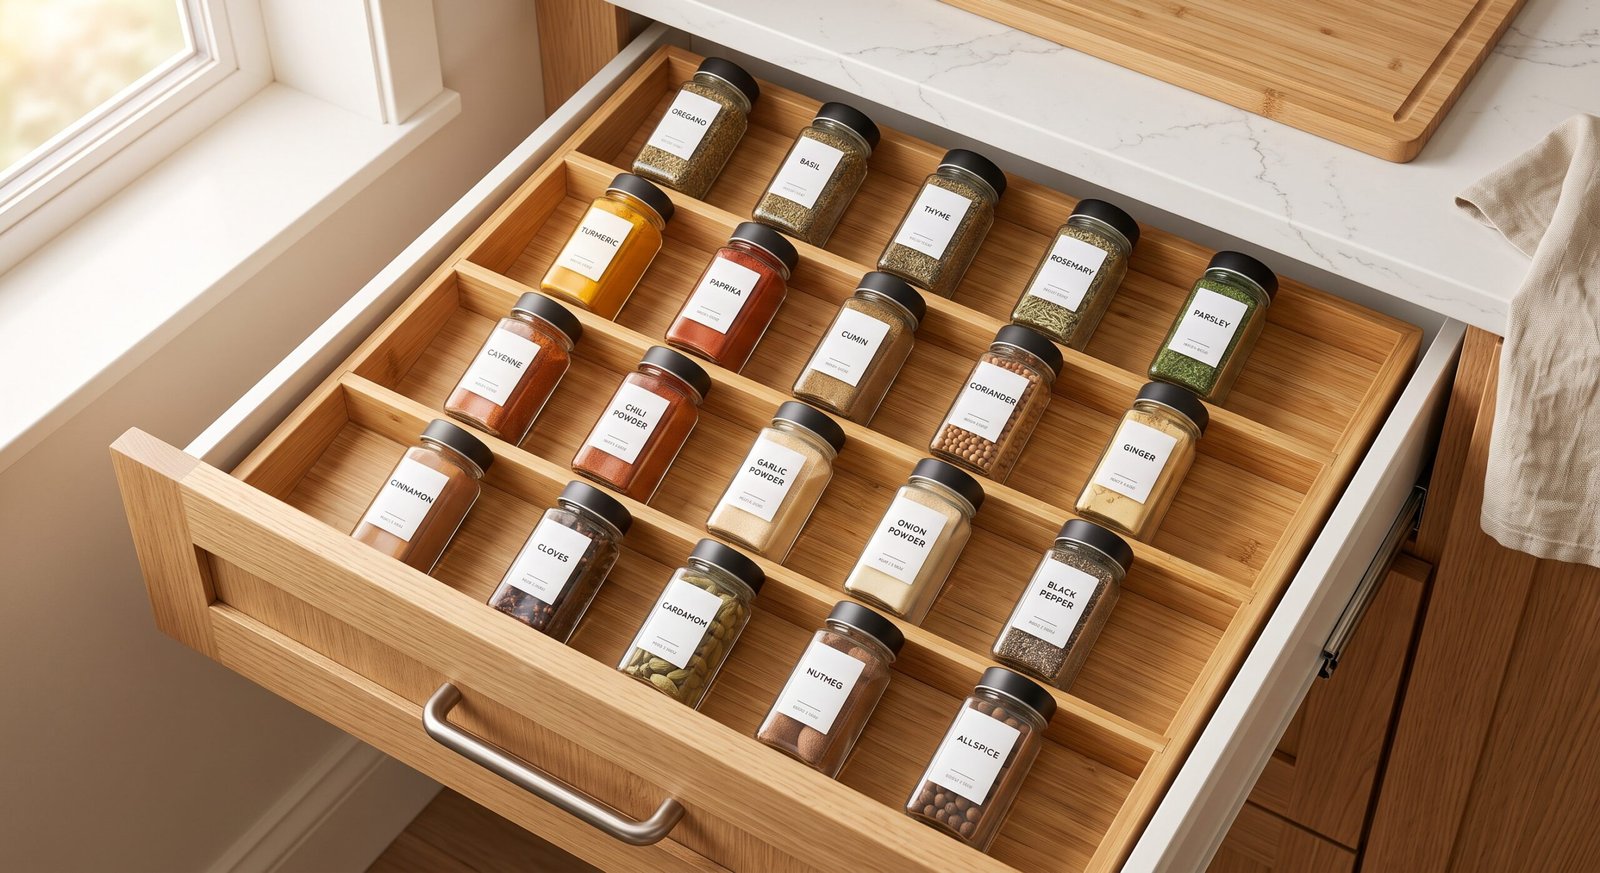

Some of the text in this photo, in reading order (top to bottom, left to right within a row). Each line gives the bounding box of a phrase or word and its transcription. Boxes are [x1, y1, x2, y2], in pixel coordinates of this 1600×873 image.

[671, 108, 707, 126] OREGANO
[799, 157, 820, 171] BASIL
[924, 205, 951, 222] THYME
[581, 226, 619, 247] TURMERIC
[1050, 254, 1095, 276] ROSEMARY
[709, 278, 742, 297] PAPRIKA
[1193, 309, 1231, 329] PARSLEY
[841, 330, 869, 346] CUMIN
[487, 349, 523, 369] CAYENNE
[969, 382, 1016, 406] CORIANDER
[612, 409, 648, 430] POWDER
[625, 403, 647, 418] CHILI
[1123, 443, 1156, 462] GINGER
[748, 466, 785, 487] POWDER
[757, 458, 788, 476] GARLIC
[390, 479, 433, 503] CINNAMON
[887, 526, 926, 548] POWDER
[897, 519, 928, 537] ONION
[537, 543, 569, 563] CLOVES
[1039, 589, 1074, 610] PEPPER
[1046, 580, 1077, 599] BLACK
[662, 601, 707, 628] CARDAMOM
[806, 667, 844, 690] NUTMEG
[956, 735, 1001, 760] ALLSPICE
